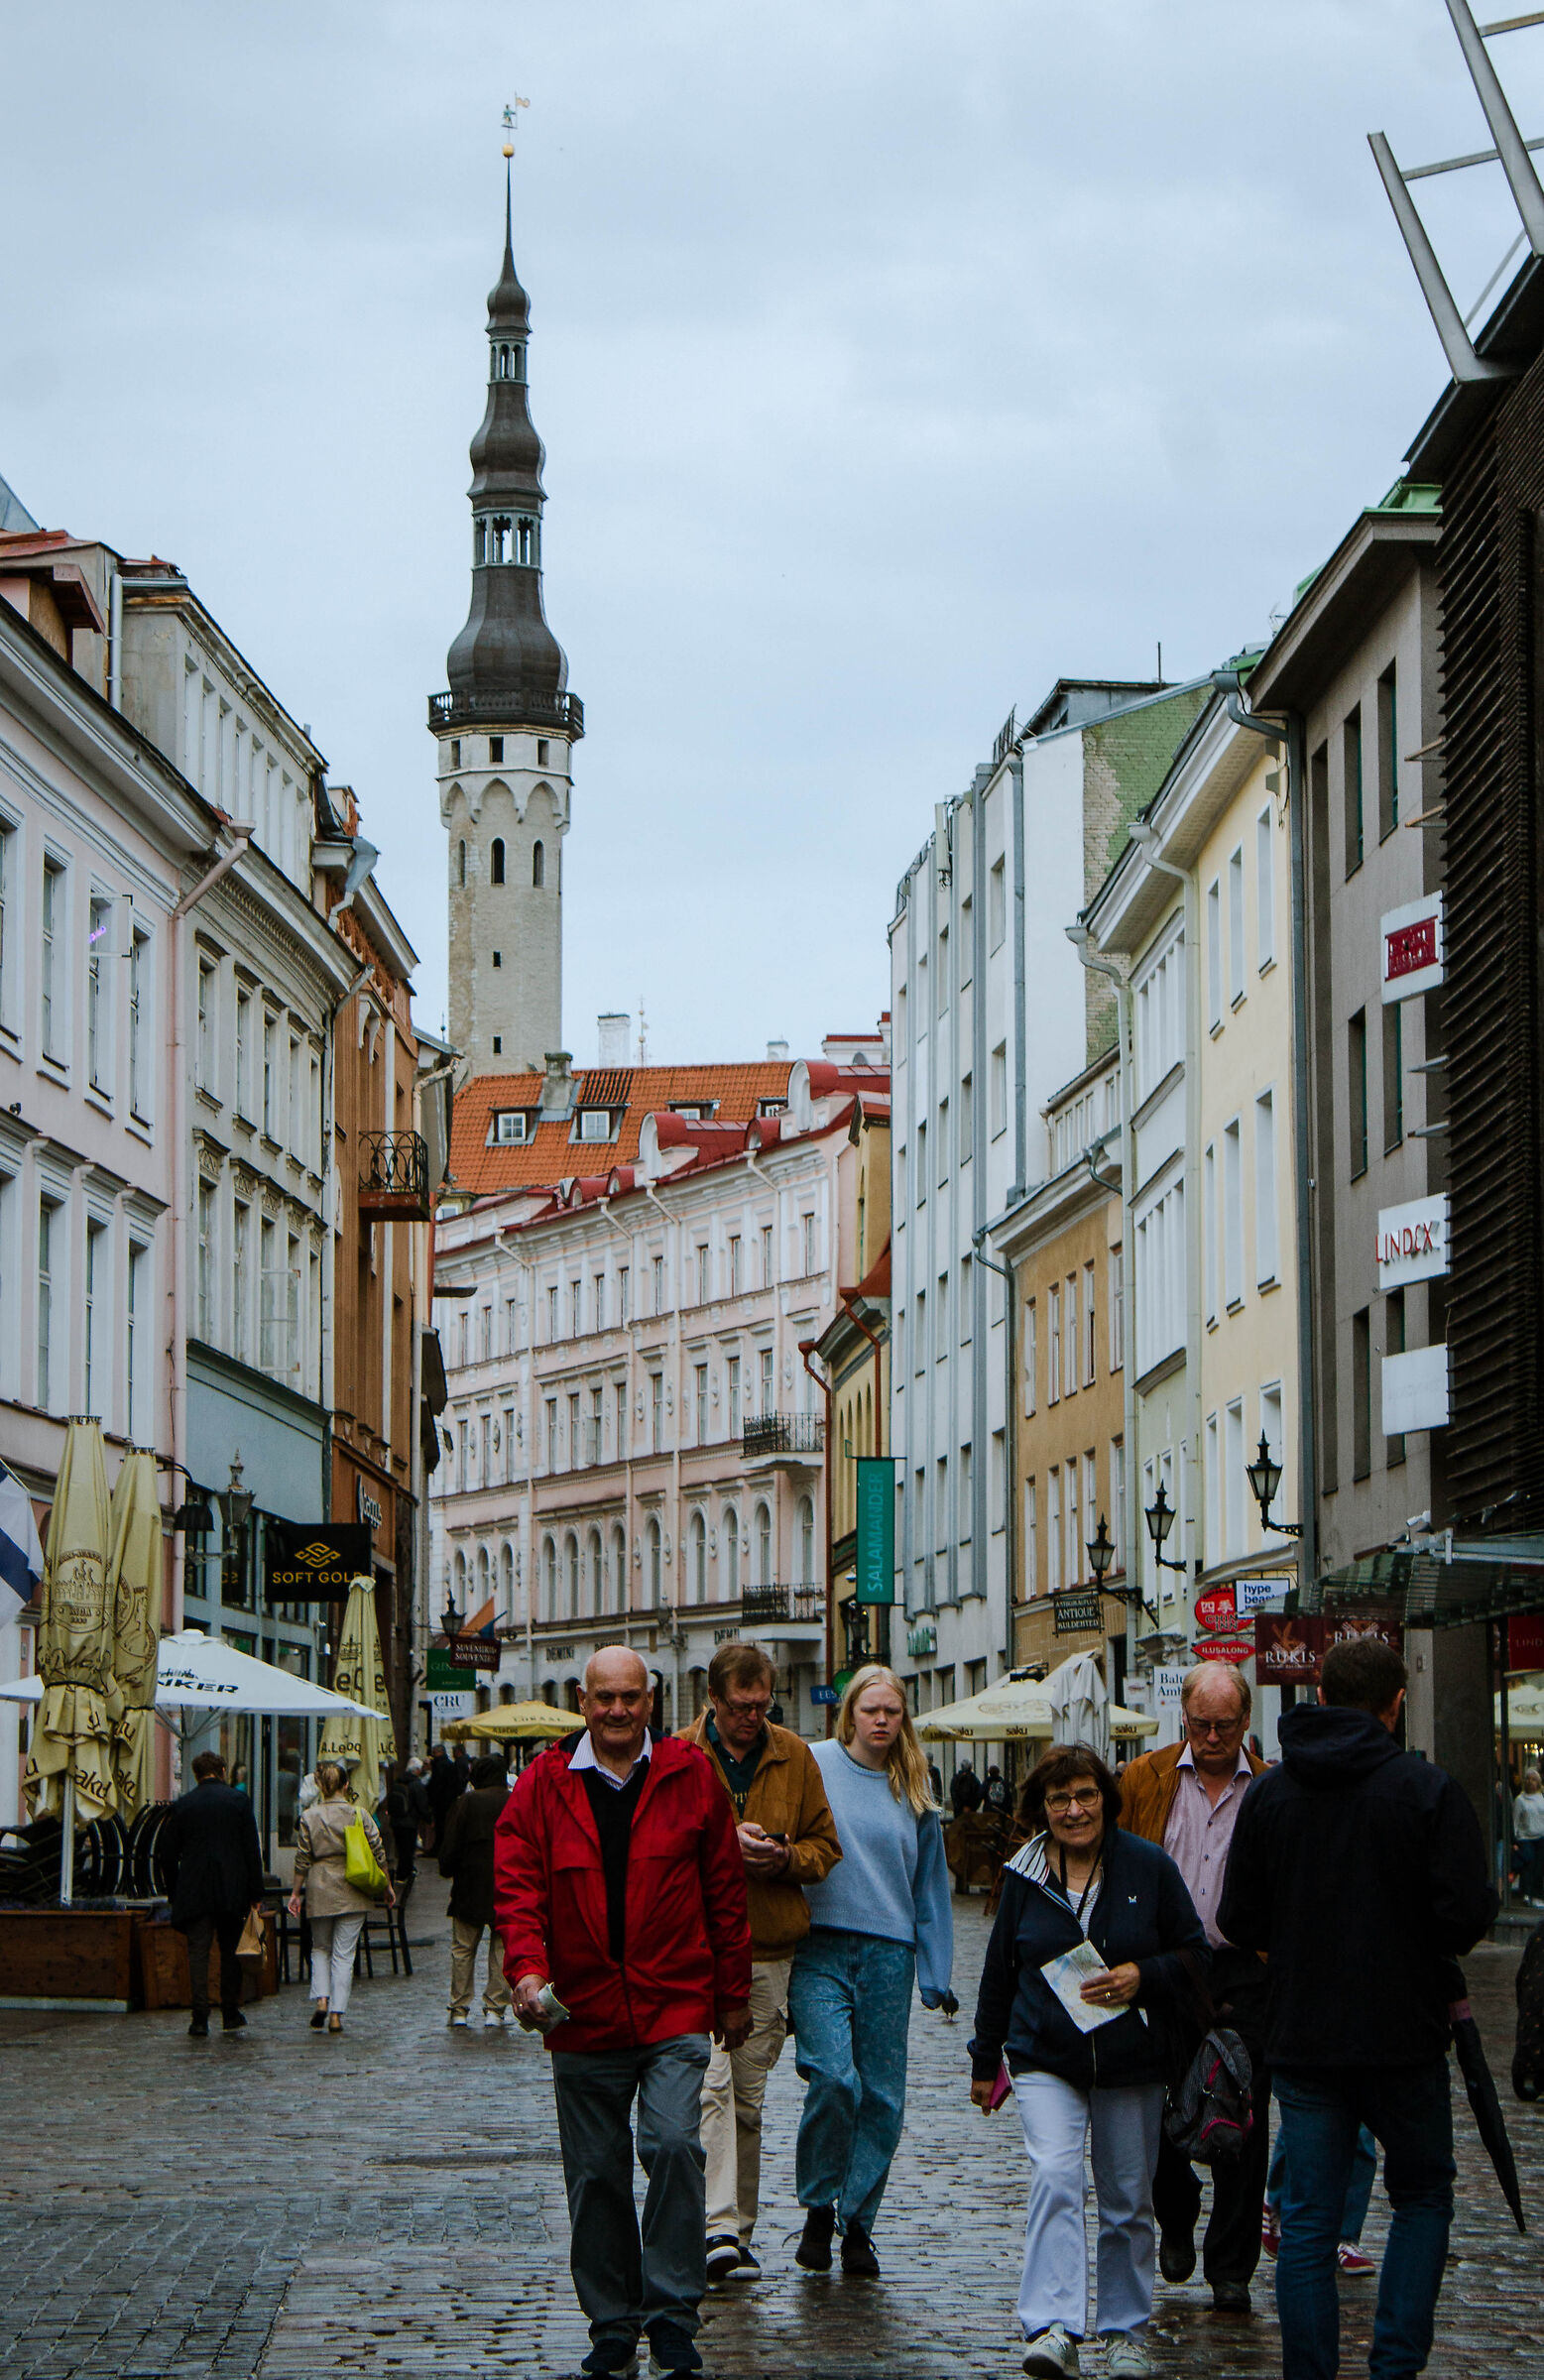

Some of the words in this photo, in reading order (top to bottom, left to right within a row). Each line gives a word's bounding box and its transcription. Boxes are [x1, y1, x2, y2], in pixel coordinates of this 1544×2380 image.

[1375, 1221, 1434, 1262] LINDEX
[868, 1474, 884, 1593] SALAMANDER
[273, 1572, 313, 1584] SOFT
[1244, 1584, 1271, 1595] hype
[1205, 1613, 1246, 1624] CHIN
[1265, 1650, 1316, 1663] RUKIS
[819, 1690, 837, 1699] EES
[1007, 1726, 1028, 1735] saku
[1116, 1726, 1137, 1734] saku
[74, 1769, 112, 1800] aku
